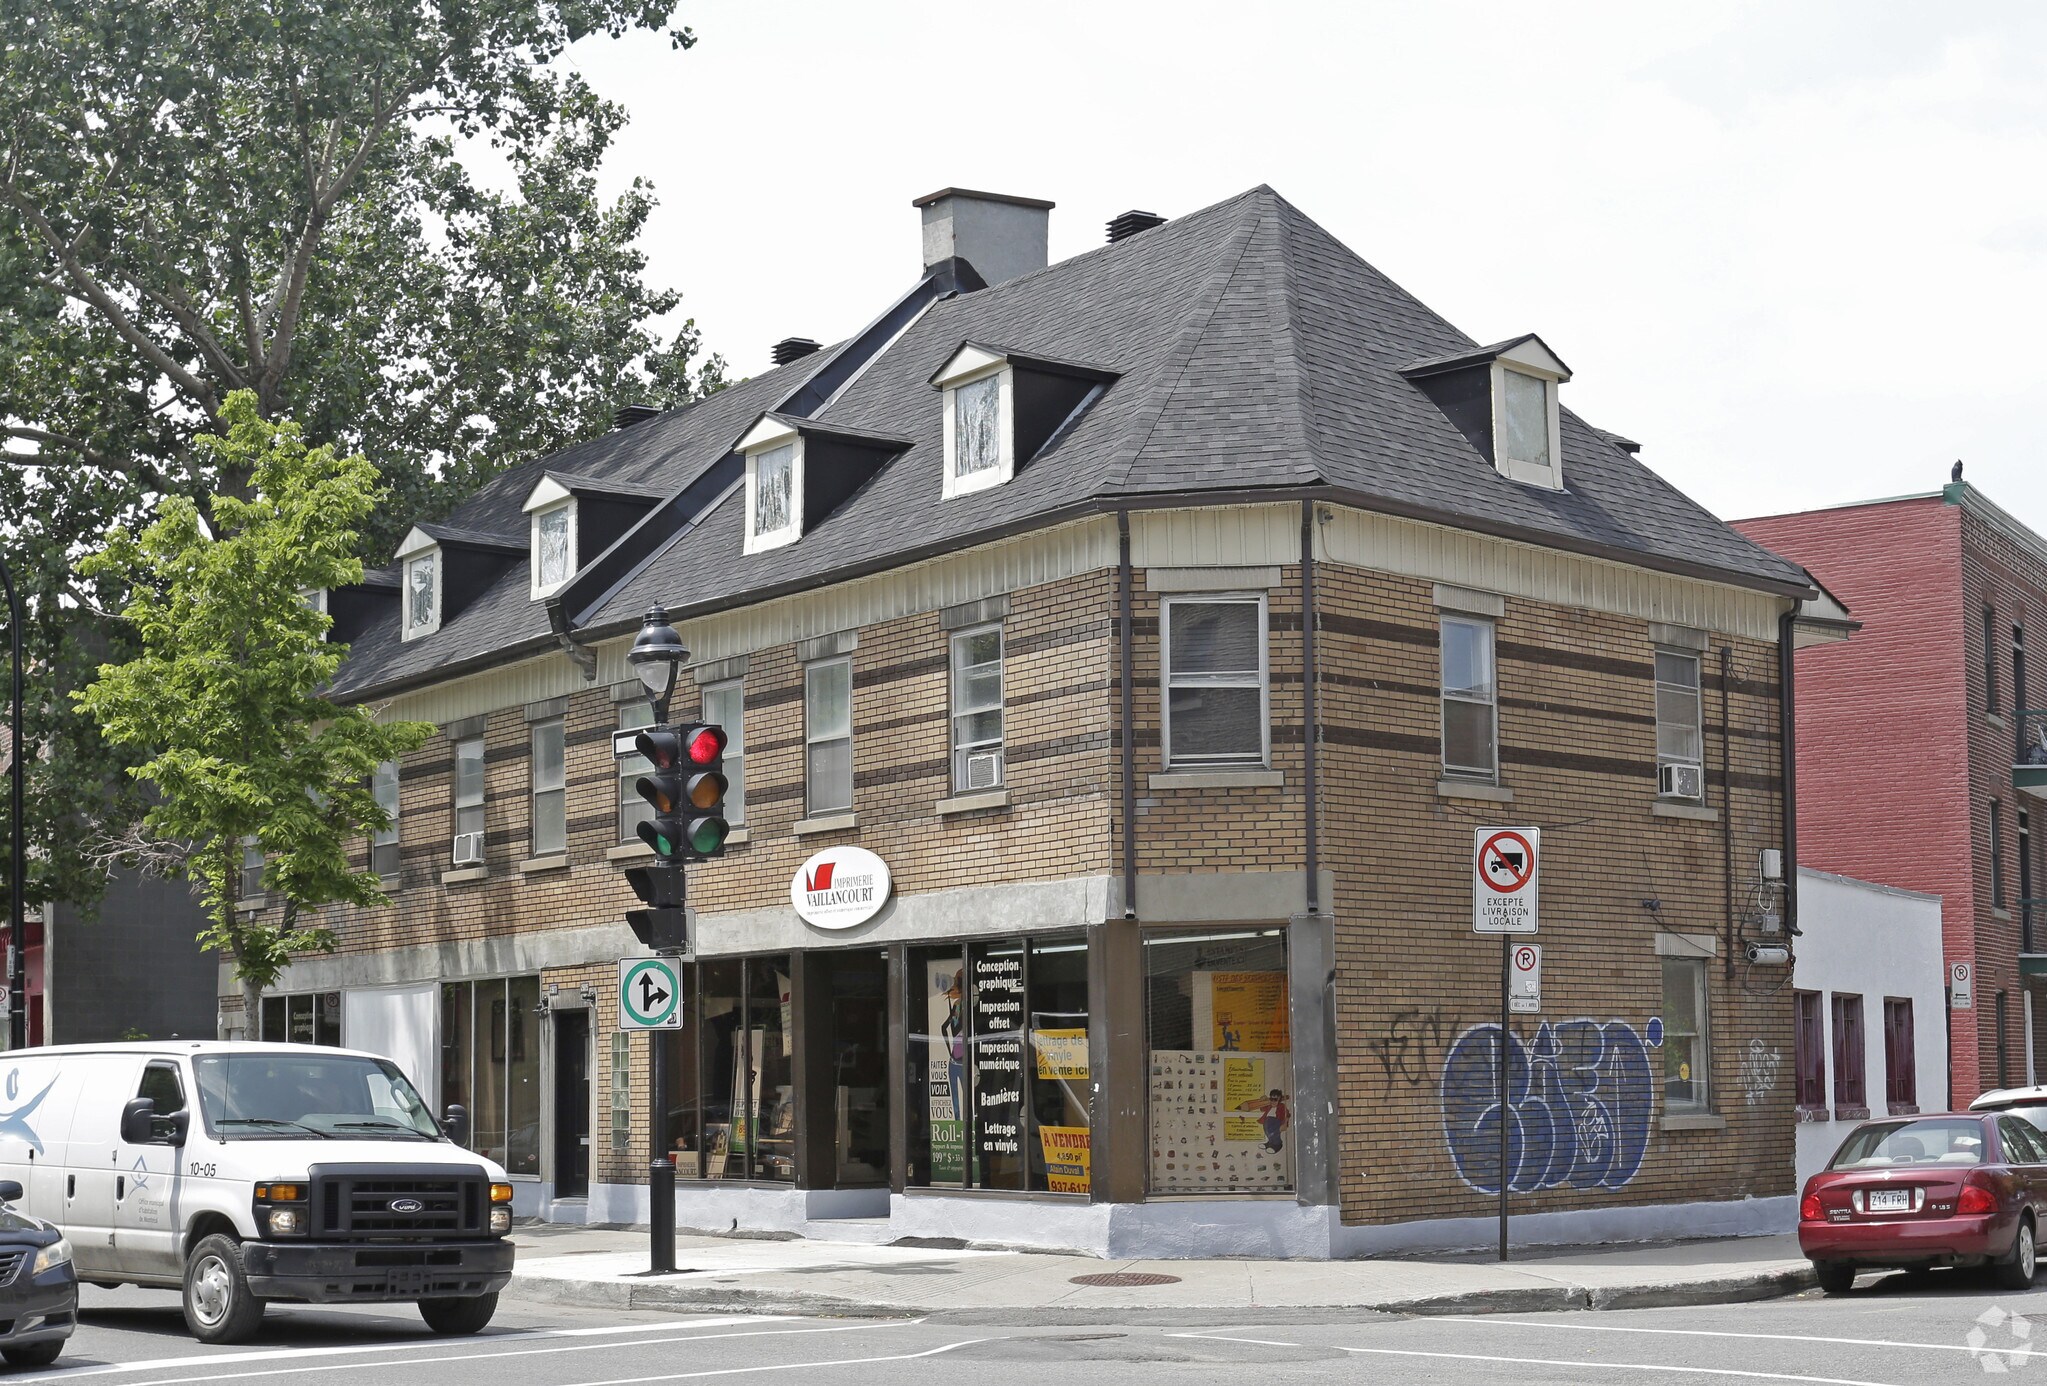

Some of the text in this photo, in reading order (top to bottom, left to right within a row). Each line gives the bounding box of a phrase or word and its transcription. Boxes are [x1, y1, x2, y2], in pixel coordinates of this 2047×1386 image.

[834, 874, 874, 889] IMPRIMERIE
[806, 887, 874, 907] VAILLANCOURT
[1487, 897, 1524, 906] EXCEPTÉ
[1483, 907, 1529, 916] LIVRAISON
[1488, 917, 1522, 926] LOCALE
[976, 959, 1019, 974] Conception
[978, 976, 1017, 992] graphique
[979, 1000, 1020, 1015] Impression
[989, 1016, 1010, 1029] offset
[1071, 1034, 1083, 1046] de
[979, 1041, 1020, 1055] Impression
[930, 1060, 948, 1069] FAITES
[979, 1057, 1020, 1072] numérique
[1038, 1064, 1088, 1075] en vente ici
[930, 1071, 948, 1080] VOUS
[930, 1084, 948, 1095] VOIR
[980, 1087, 1020, 1106] Bannières
[930, 1107, 953, 1119] VOUS
[984, 1121, 1016, 1137] Lettrage
[1042, 1128, 1050, 1147] À
[983, 1139, 1018, 1154] en vinyle
[947, 1152, 952, 1163] $
[190, 1162, 217, 1177] 10-05
[1050, 1165, 1063, 1173] Alain
[1063, 1166, 1080, 1174] Duval
[1871, 1194, 1908, 1206] Z14 FRH
